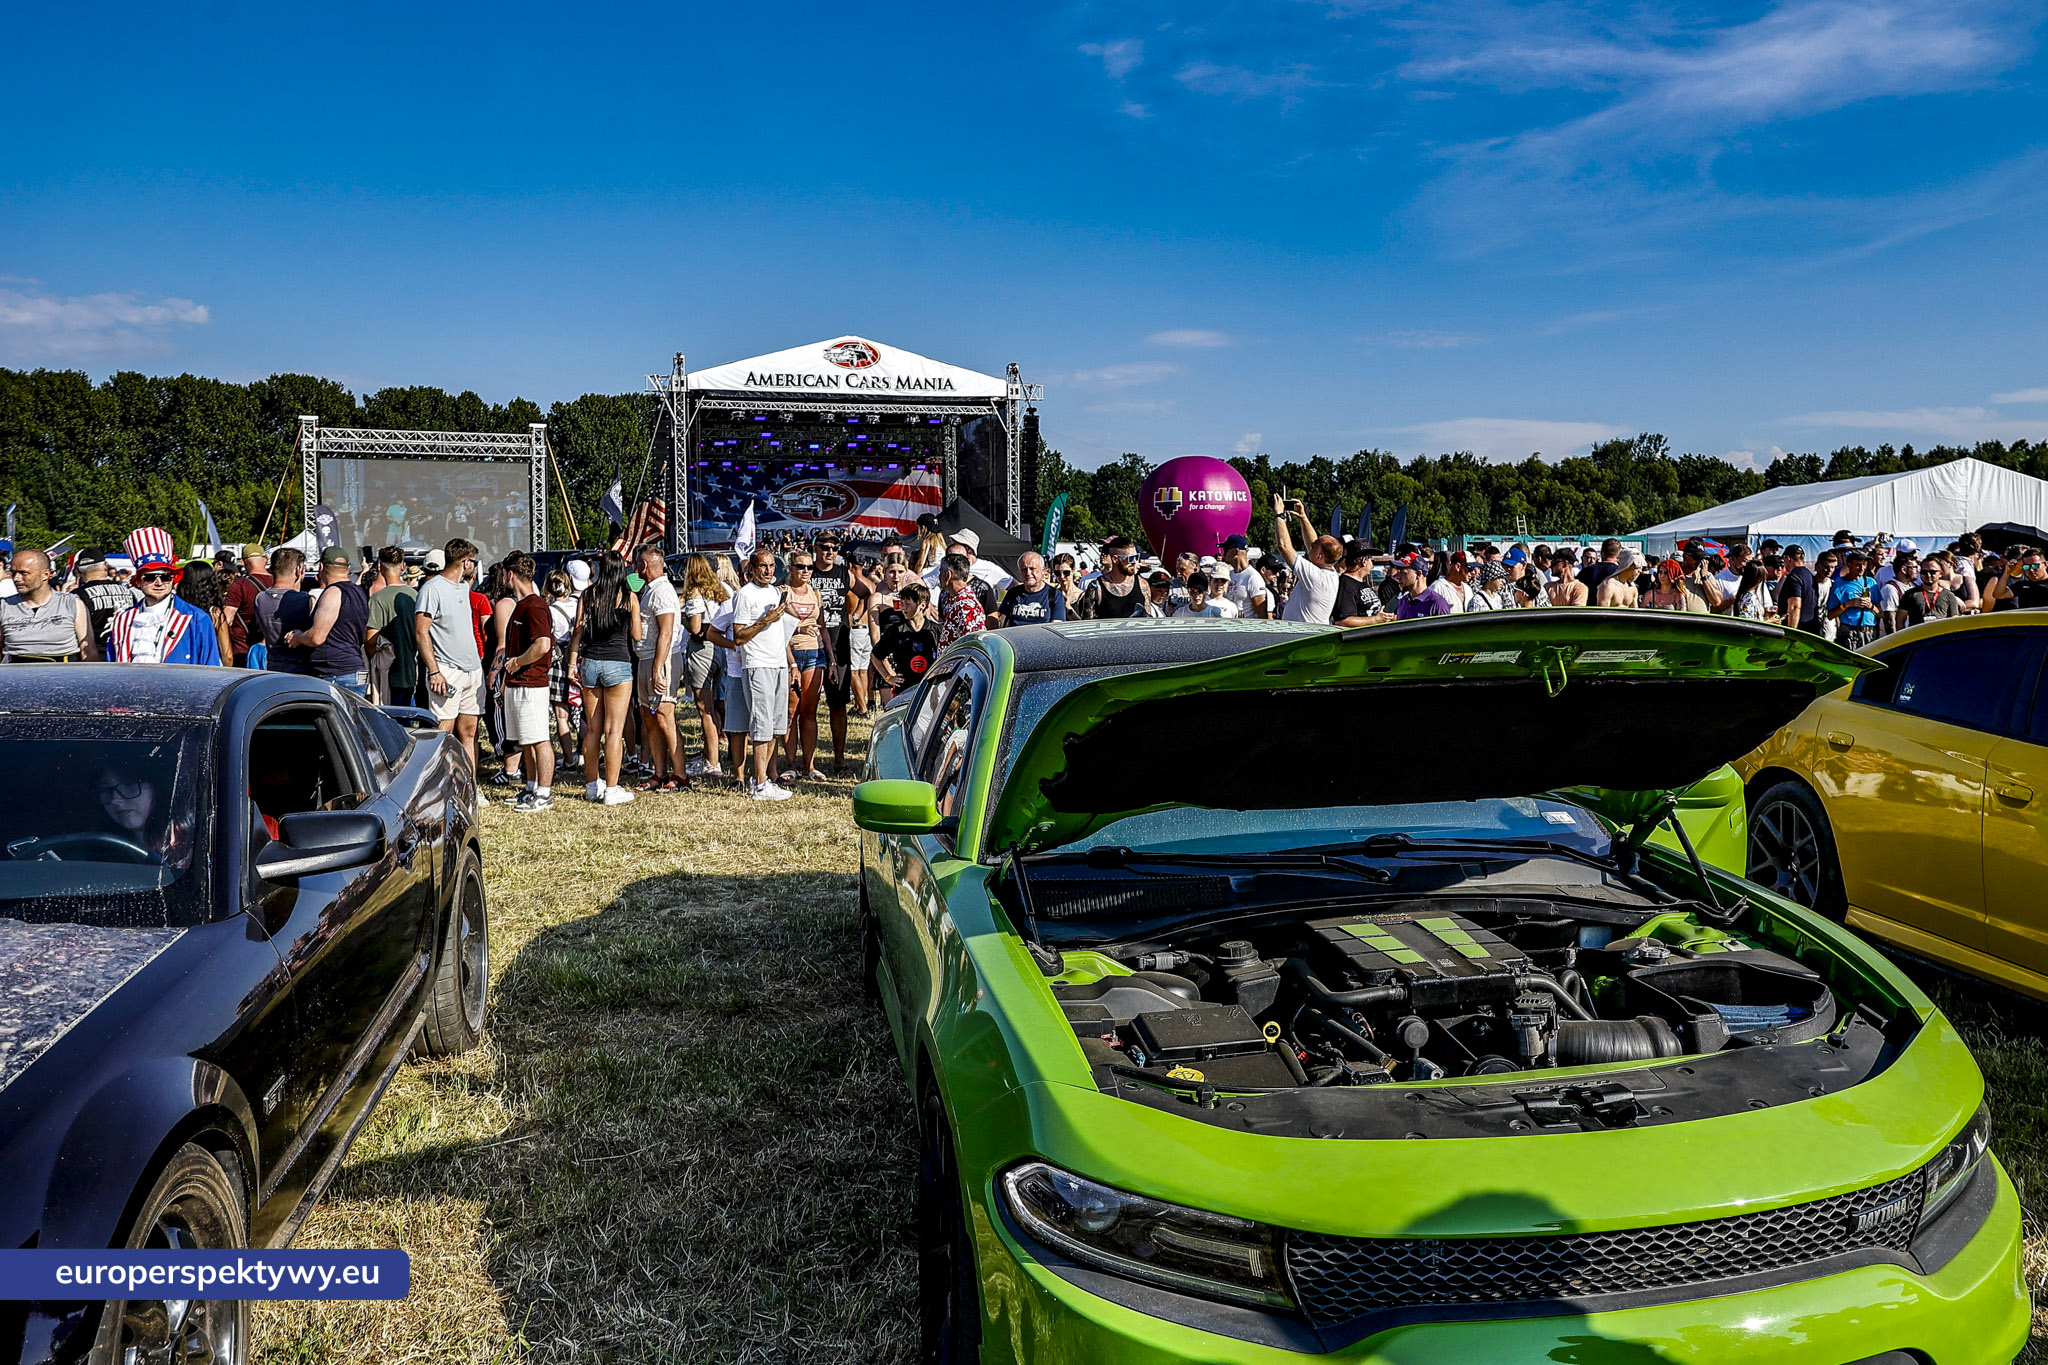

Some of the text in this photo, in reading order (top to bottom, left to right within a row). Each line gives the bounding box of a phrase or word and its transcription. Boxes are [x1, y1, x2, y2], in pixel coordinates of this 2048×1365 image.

[744, 371, 956, 391] AMERICAN CARS MANIA
[1189, 490, 1247, 502] KATOWICE
[1189, 503, 1198, 511] for
[1204, 503, 1226, 511] change
[1858, 1197, 1910, 1231] DAYTONA
